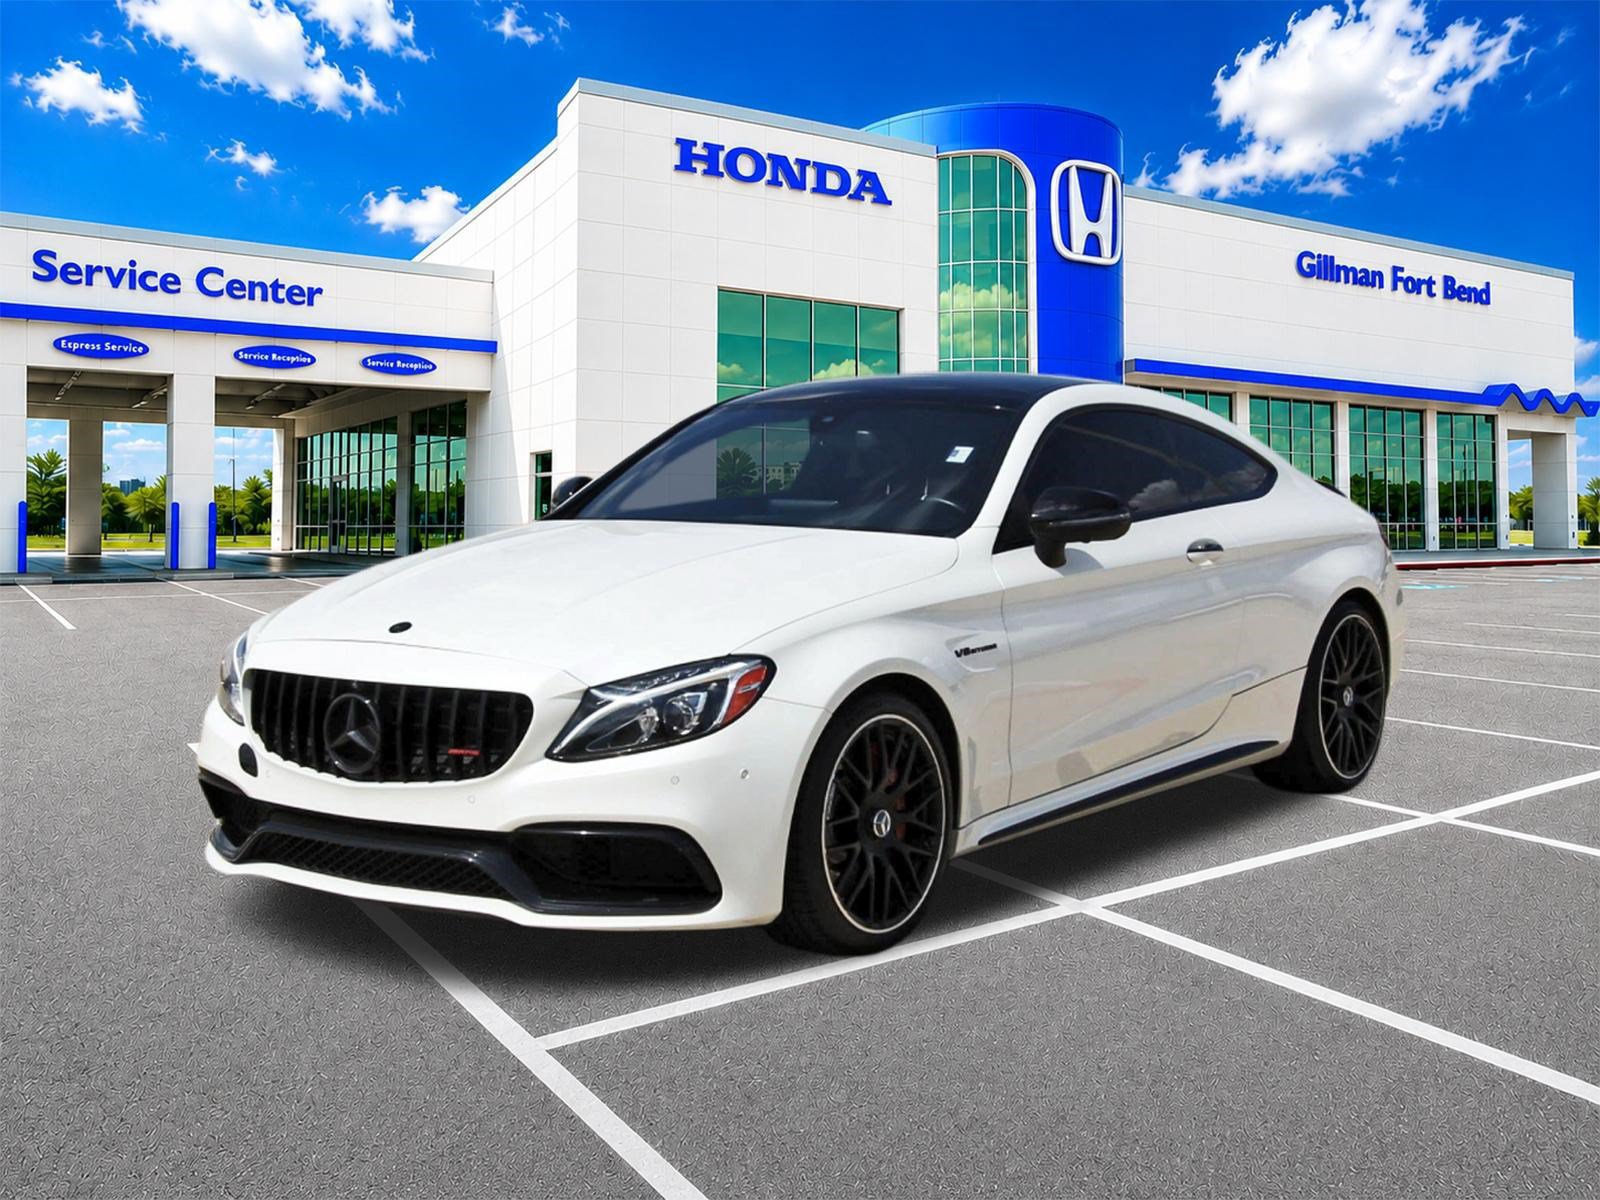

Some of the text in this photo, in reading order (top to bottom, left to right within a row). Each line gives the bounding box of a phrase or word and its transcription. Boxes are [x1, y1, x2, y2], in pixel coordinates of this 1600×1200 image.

[673, 138, 892, 206] HONDA
[32, 249, 323, 307] Service Center
[1296, 250, 1492, 305] Gillman Fort Bend
[104, 342, 143, 353] Service
[238, 351, 269, 360] Service
